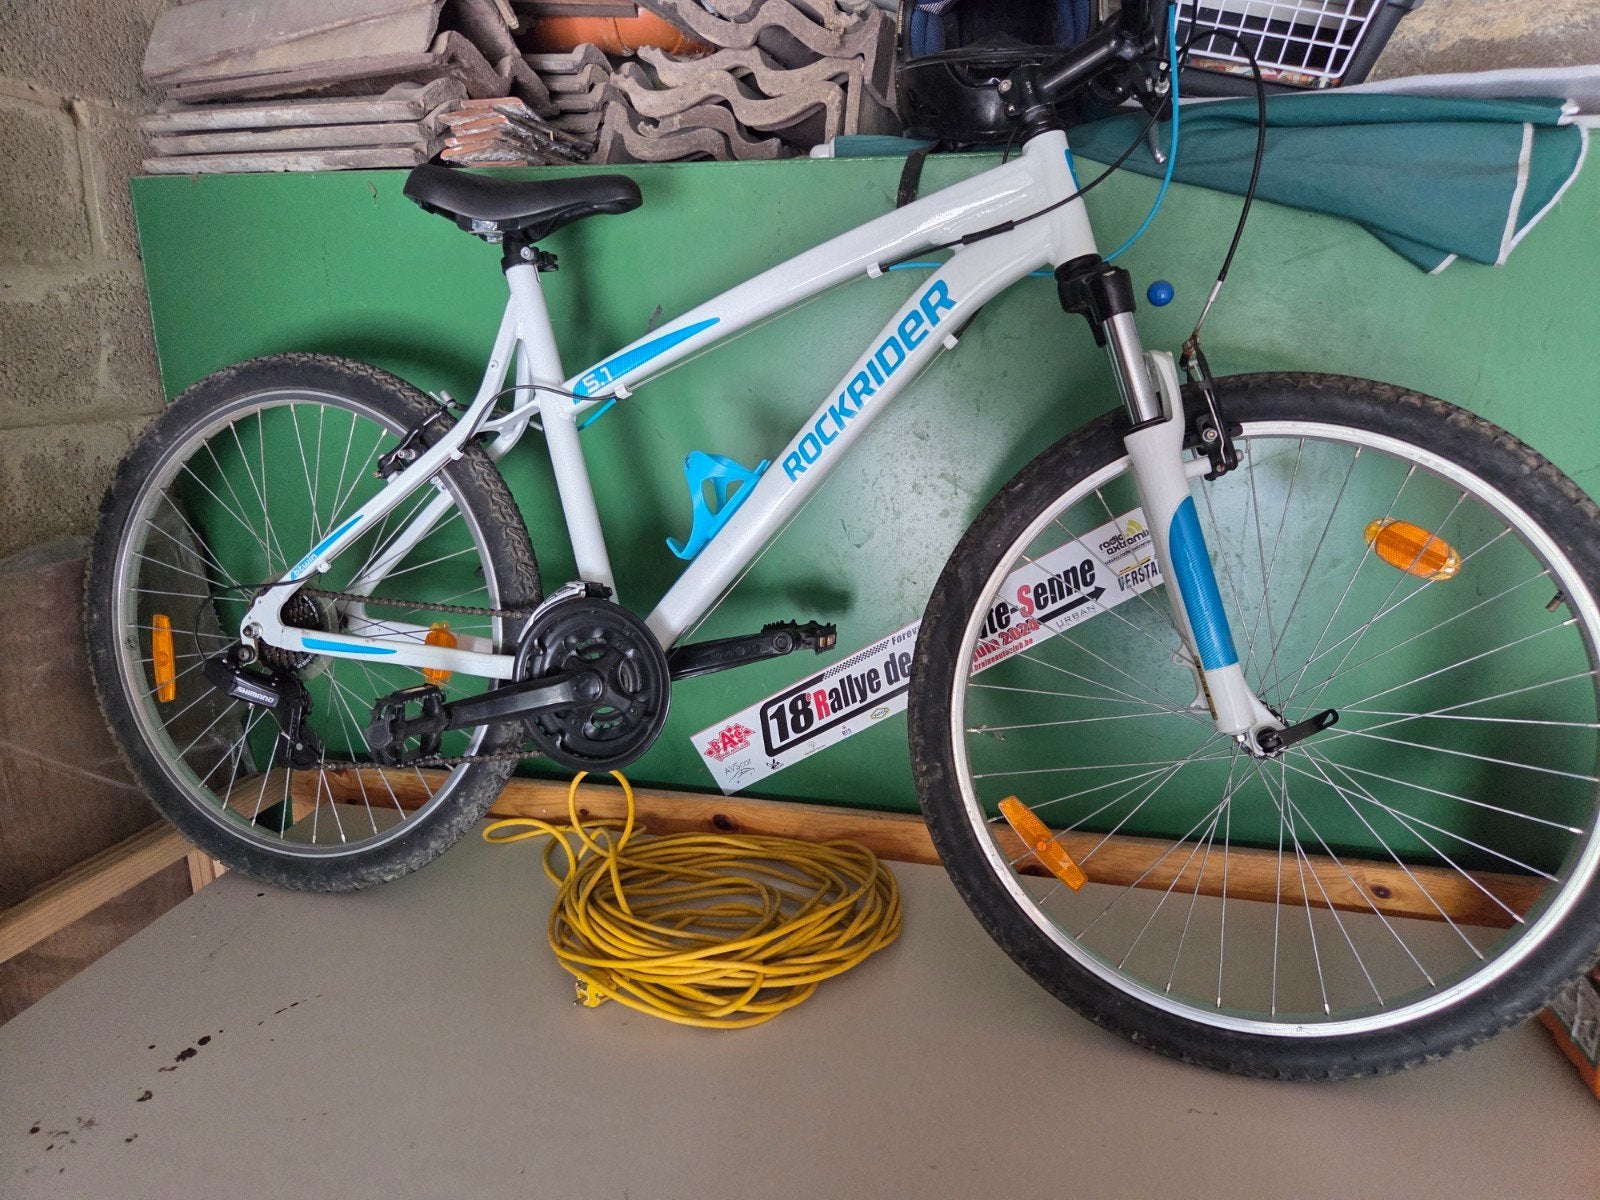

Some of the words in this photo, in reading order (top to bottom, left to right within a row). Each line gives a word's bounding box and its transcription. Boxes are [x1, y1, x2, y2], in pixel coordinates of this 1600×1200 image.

[583, 366, 614, 392] 5.1
[1117, 561, 1162, 592] VERSTA
[1055, 604, 1097, 628] URBAN
[1000, 617, 1040, 647] 2024
[236, 686, 275, 703] SHIMANO
[813, 668, 882, 721] Rallye
[885, 651, 913, 685] de
